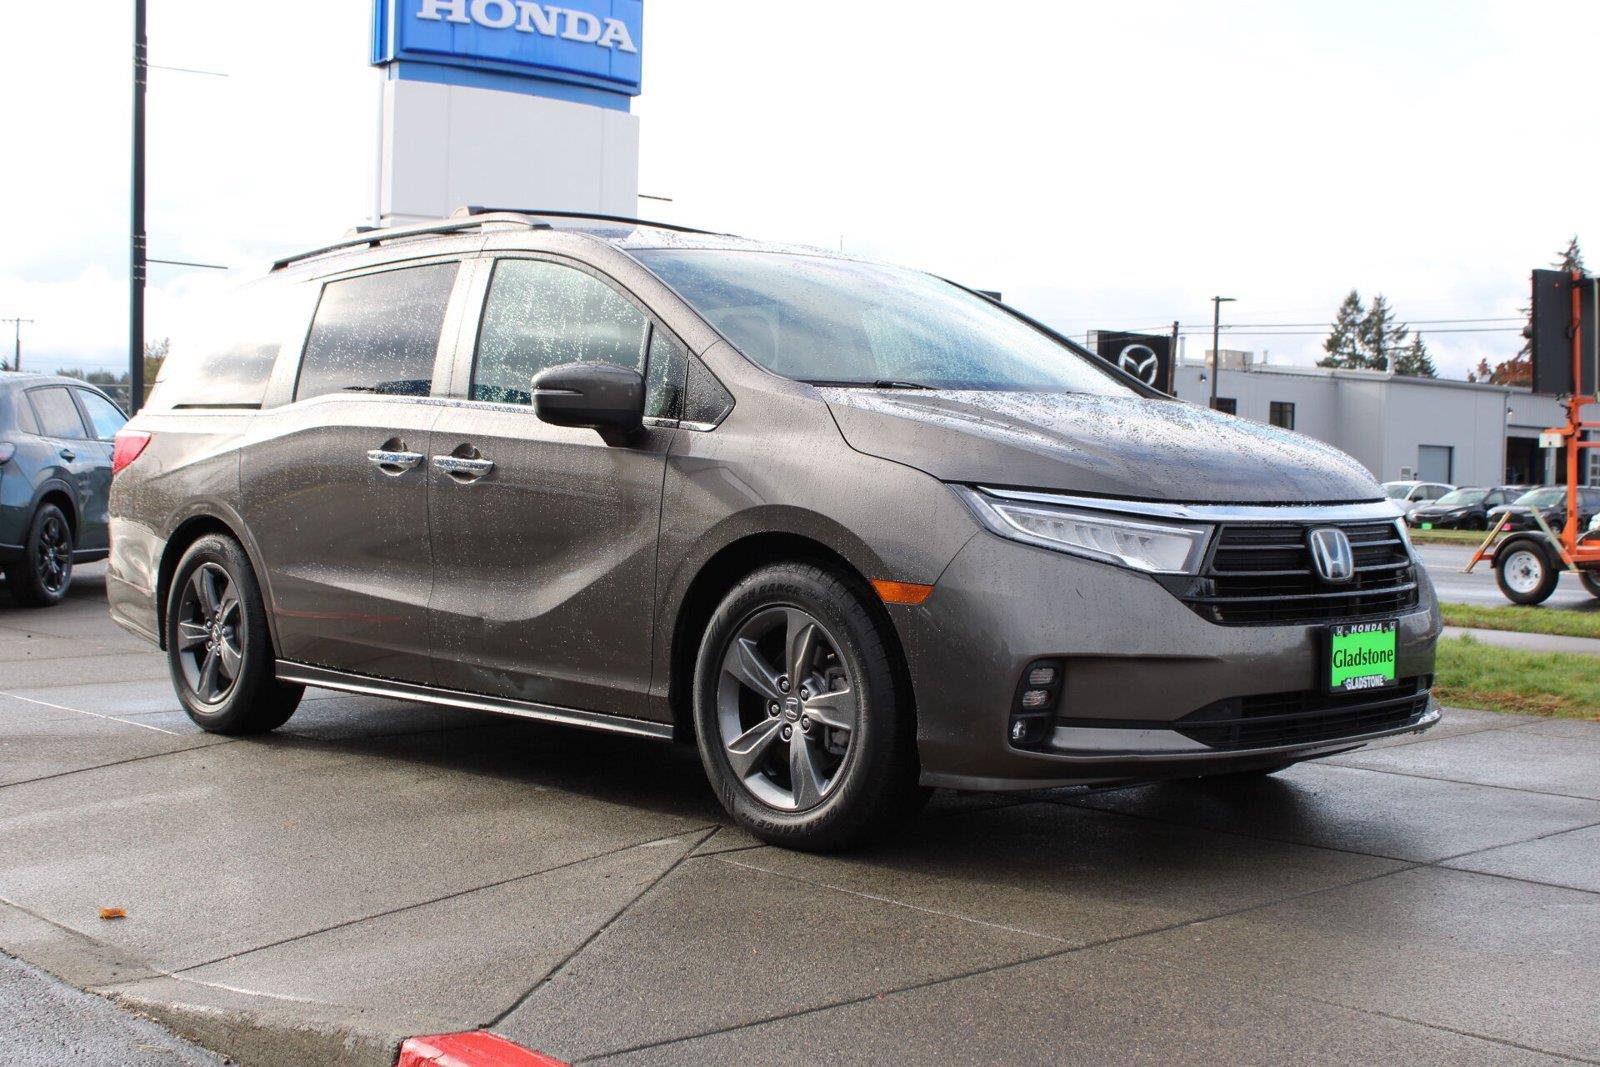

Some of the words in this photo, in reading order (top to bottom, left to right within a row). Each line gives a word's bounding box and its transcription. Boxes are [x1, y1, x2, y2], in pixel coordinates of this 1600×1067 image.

[416, 0, 638, 53] HONDA
[1351, 623, 1382, 634] HONDA
[1333, 647, 1394, 669] Gladstone
[1345, 674, 1384, 690] GLADSTONE
